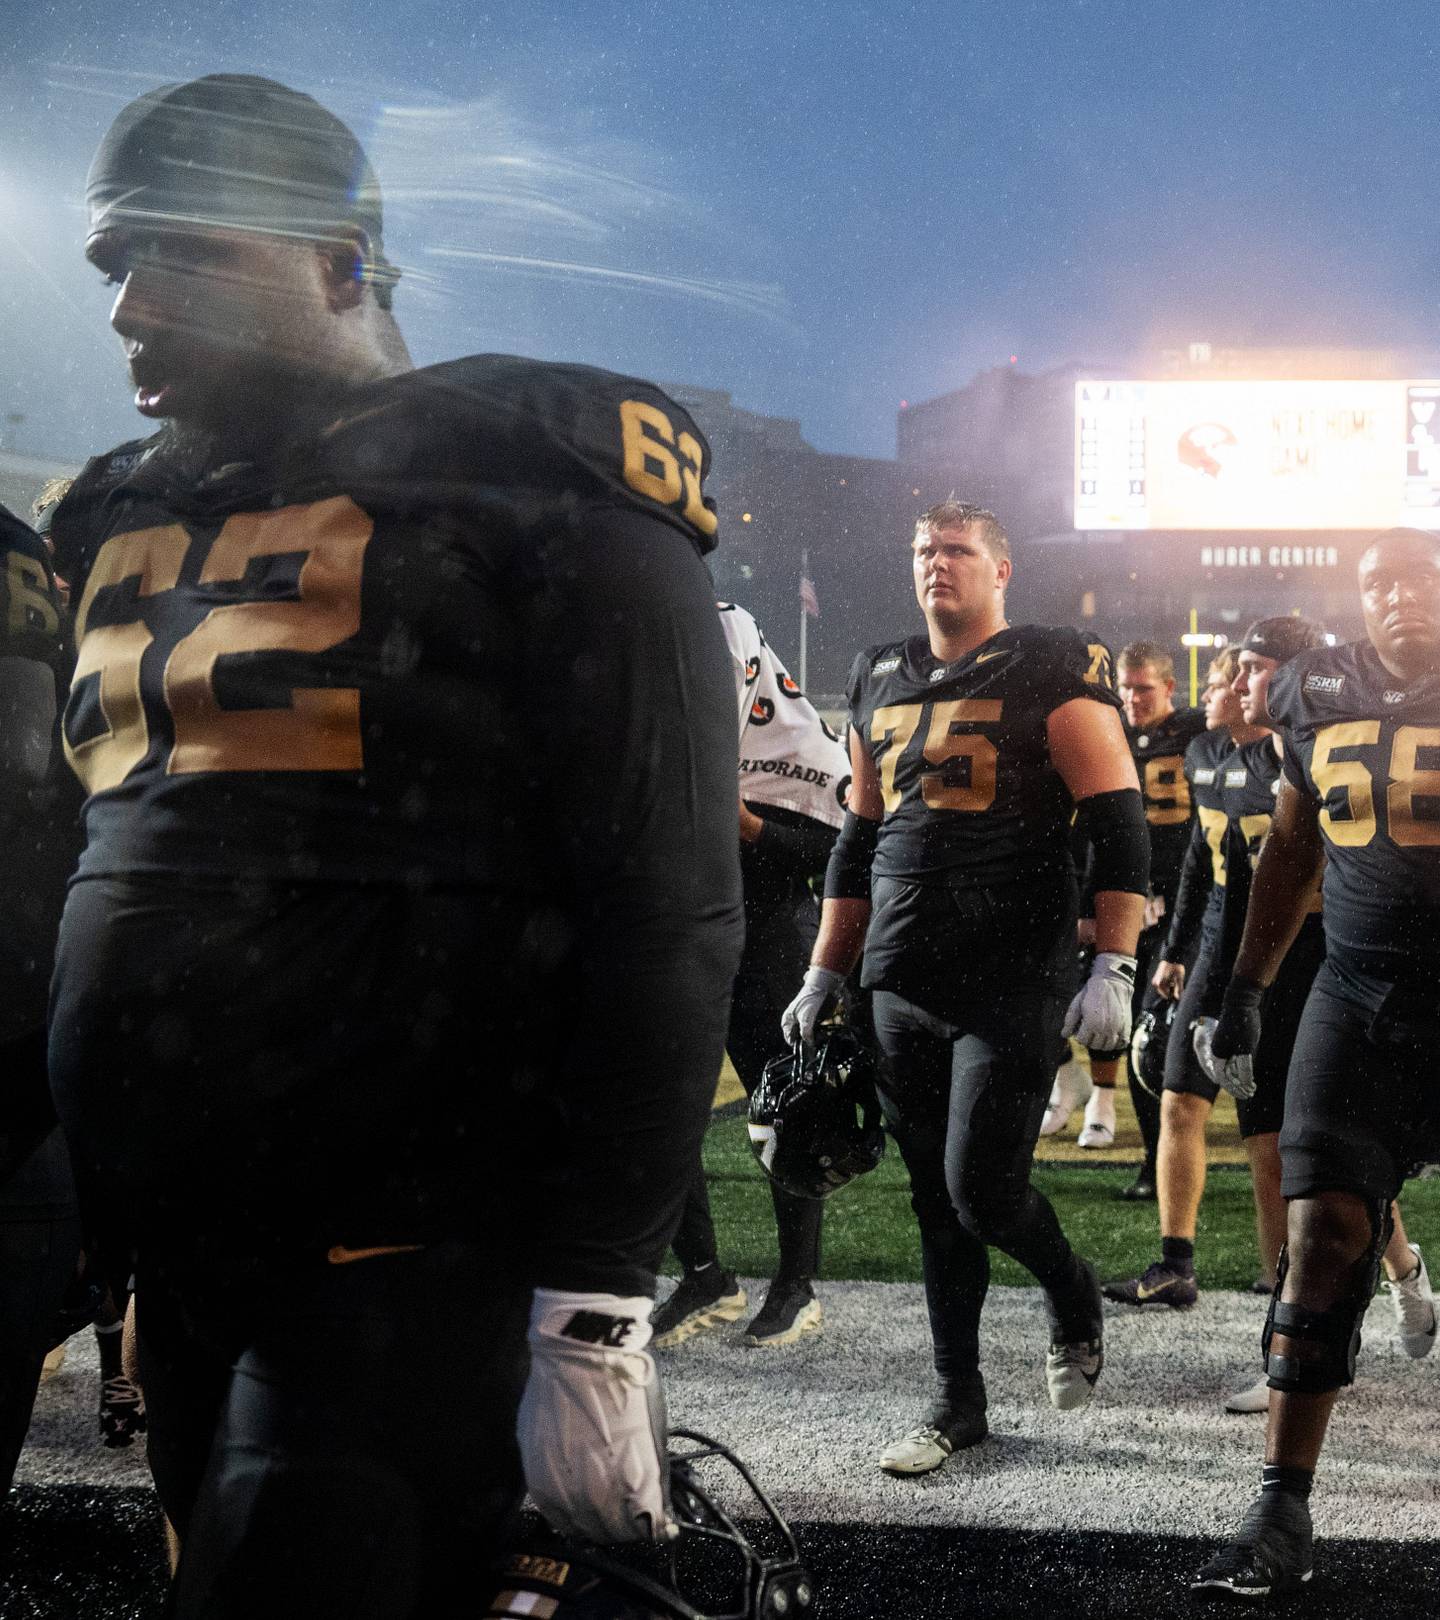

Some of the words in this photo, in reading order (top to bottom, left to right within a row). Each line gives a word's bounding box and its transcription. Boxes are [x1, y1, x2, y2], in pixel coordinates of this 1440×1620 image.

[62, 495, 374, 796] 62
[738, 758, 834, 789] ATORADE
[870, 698, 1003, 813] 75
[1144, 755, 1192, 826] 9
